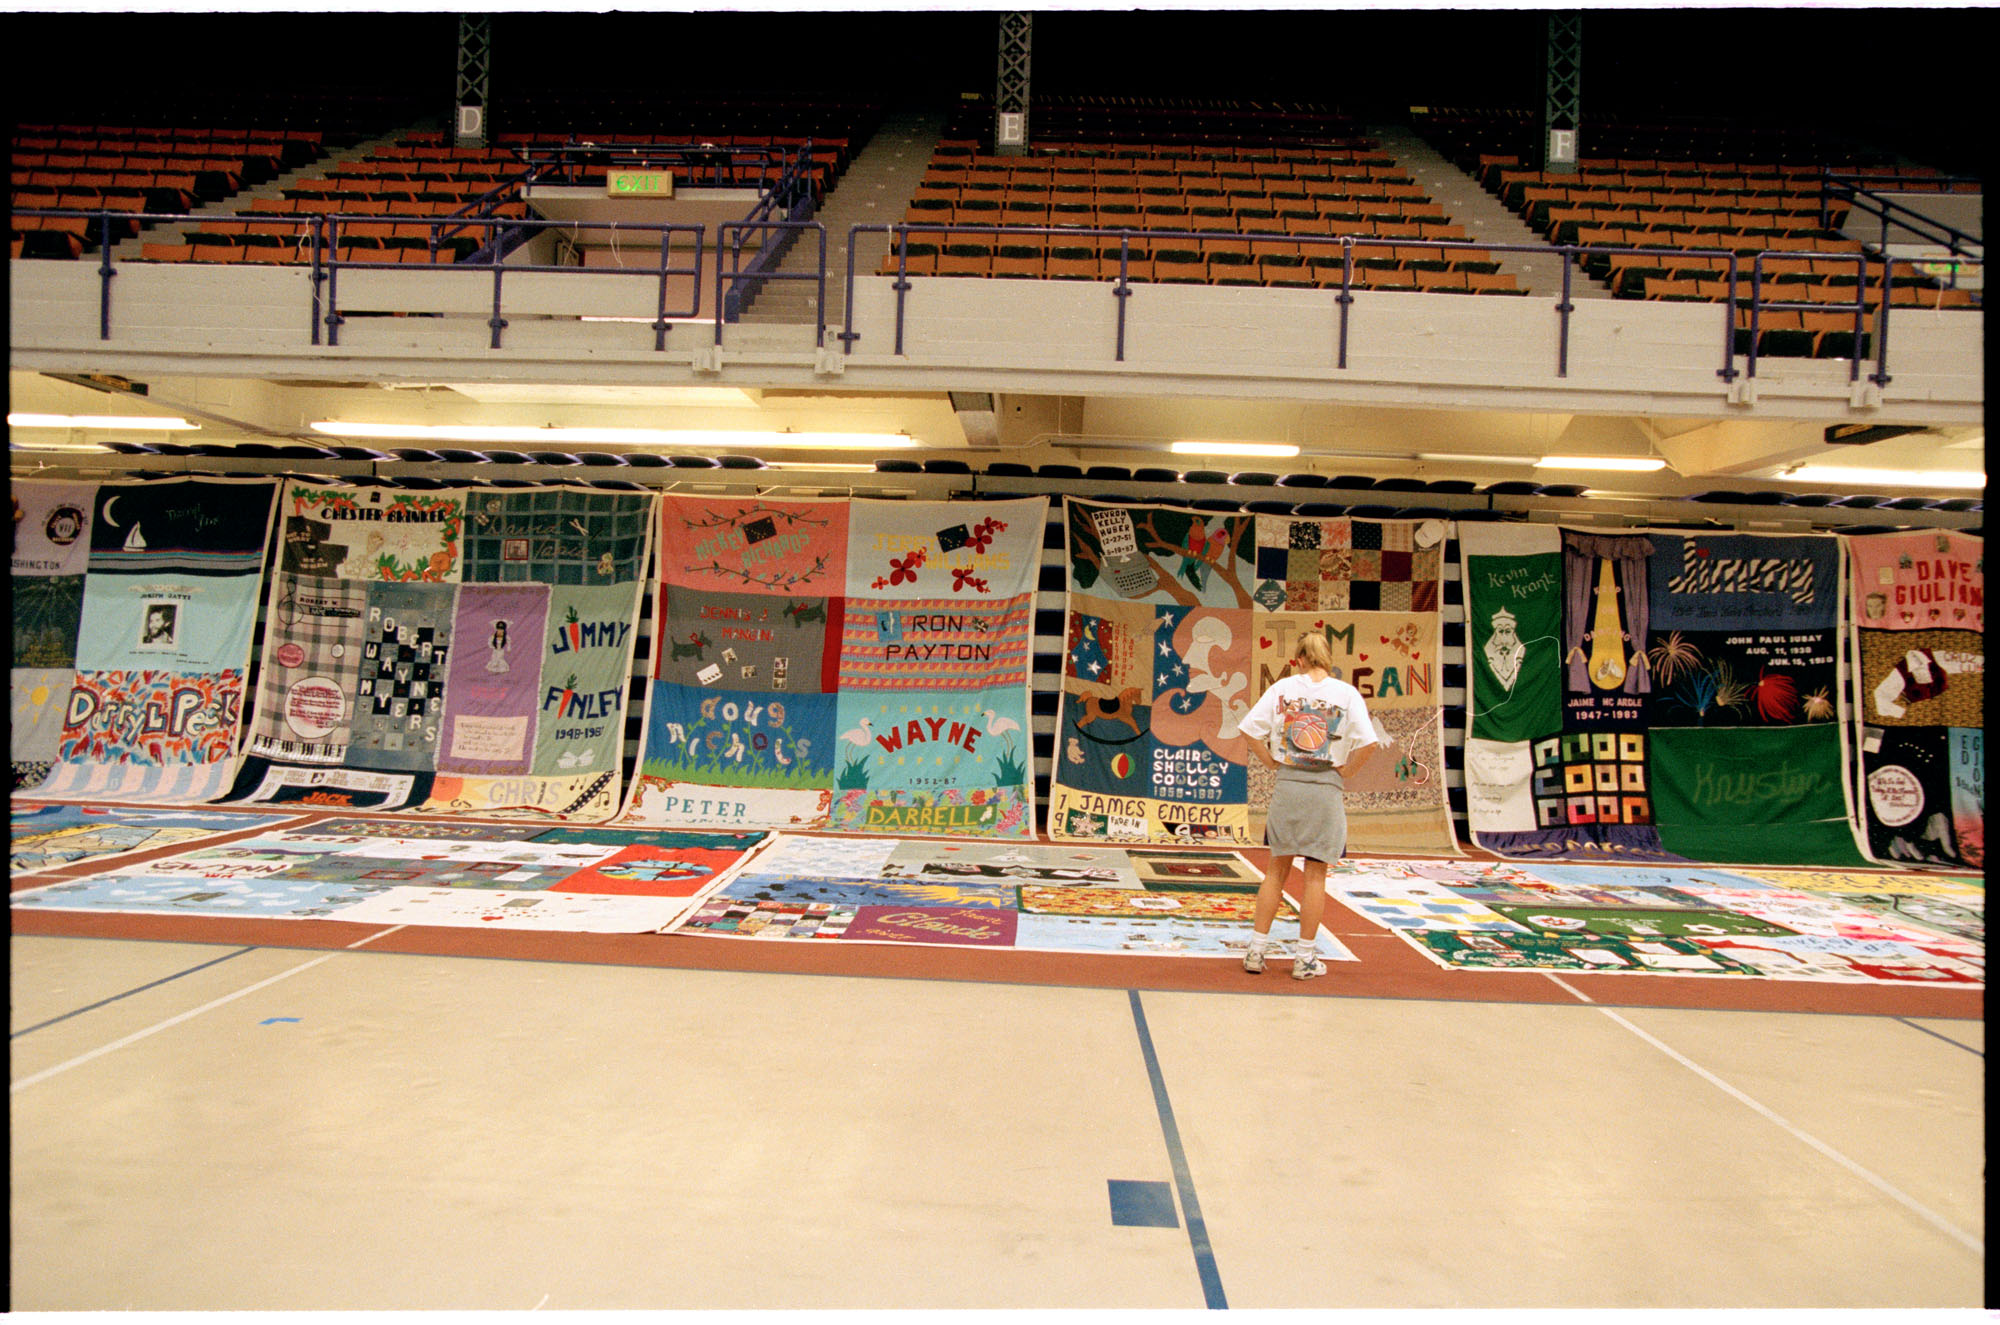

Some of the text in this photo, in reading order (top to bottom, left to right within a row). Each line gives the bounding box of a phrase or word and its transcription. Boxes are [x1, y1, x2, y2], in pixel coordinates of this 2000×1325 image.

[460, 106, 481, 134] D
[1003, 114, 1021, 141] E
[1556, 132, 1572, 158] F
[616, 174, 663, 191] EXIT
[321, 507, 447, 523] CHESTER BRINKER
[12, 559, 60, 569] SHINGTON
[926, 552, 1010, 571] WILLIAMS
[1916, 559, 1971, 583] DAVE
[912, 614, 964, 633] RON
[369, 607, 445, 666] ROBERT
[552, 621, 632, 655] JIMMY
[1265, 620, 1355, 658] TM
[1726, 637, 1753, 645] JOHN
[1759, 635, 1787, 644] PAUL
[886, 643, 991, 662] PAYTON
[365, 643, 441, 712] WAYNE
[1260, 663, 1433, 699] MGAN
[361, 679, 437, 742] MYERS
[543, 684, 624, 721] FINLEY
[700, 696, 786, 728] doug
[1568, 698, 1595, 707] JAIME
[875, 717, 983, 754] WAYNE
[1153, 748, 1212, 761] CLAIRE
[1152, 773, 1221, 788] COWLES
[1153, 762, 1230, 775] SHELLEY
[302, 791, 353, 806] JACK
[489, 781, 562, 805] CHRIS
[665, 796, 747, 818] PETER
[868, 806, 978, 827] DARRELL
[1079, 794, 1225, 823] JAMES EMERY
